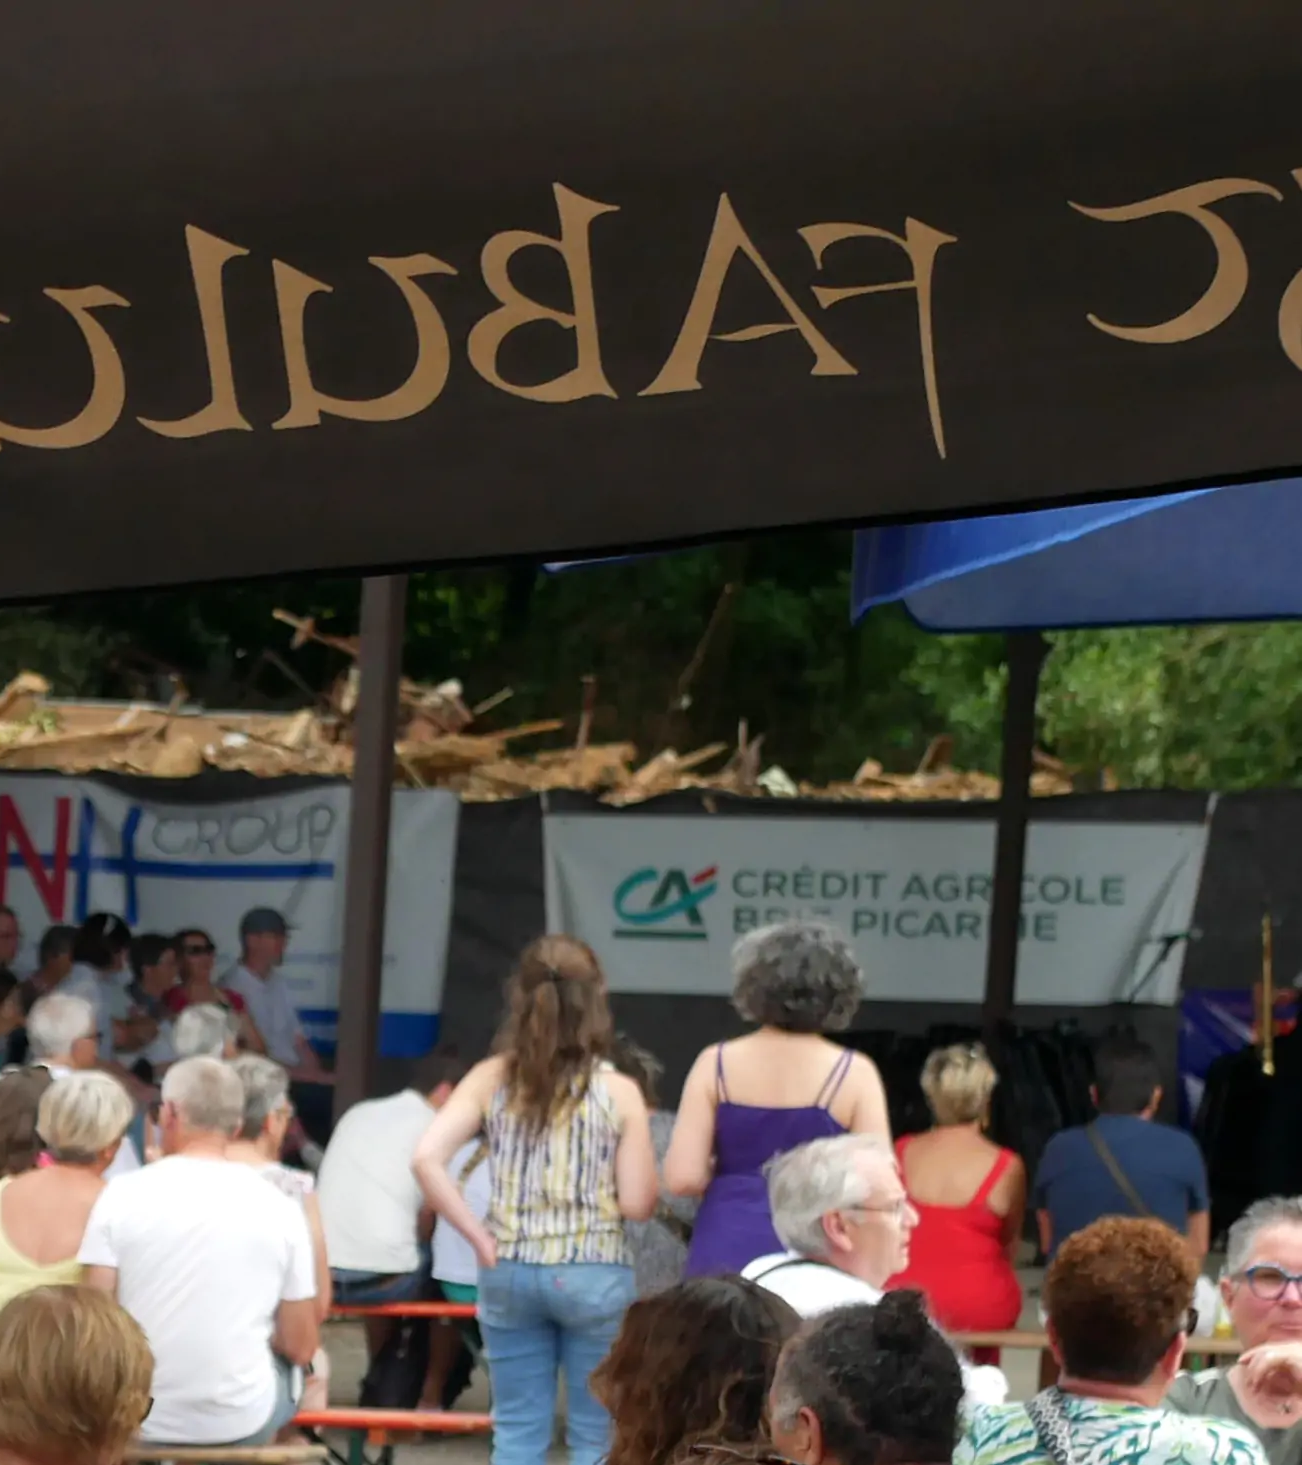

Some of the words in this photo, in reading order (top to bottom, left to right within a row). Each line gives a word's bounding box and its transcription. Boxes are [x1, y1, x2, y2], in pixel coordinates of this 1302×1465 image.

[731, 862, 888, 901] CRÉDIT
[901, 872, 1126, 907] AGRCOLE
[852, 909, 1059, 942] PICARIE
